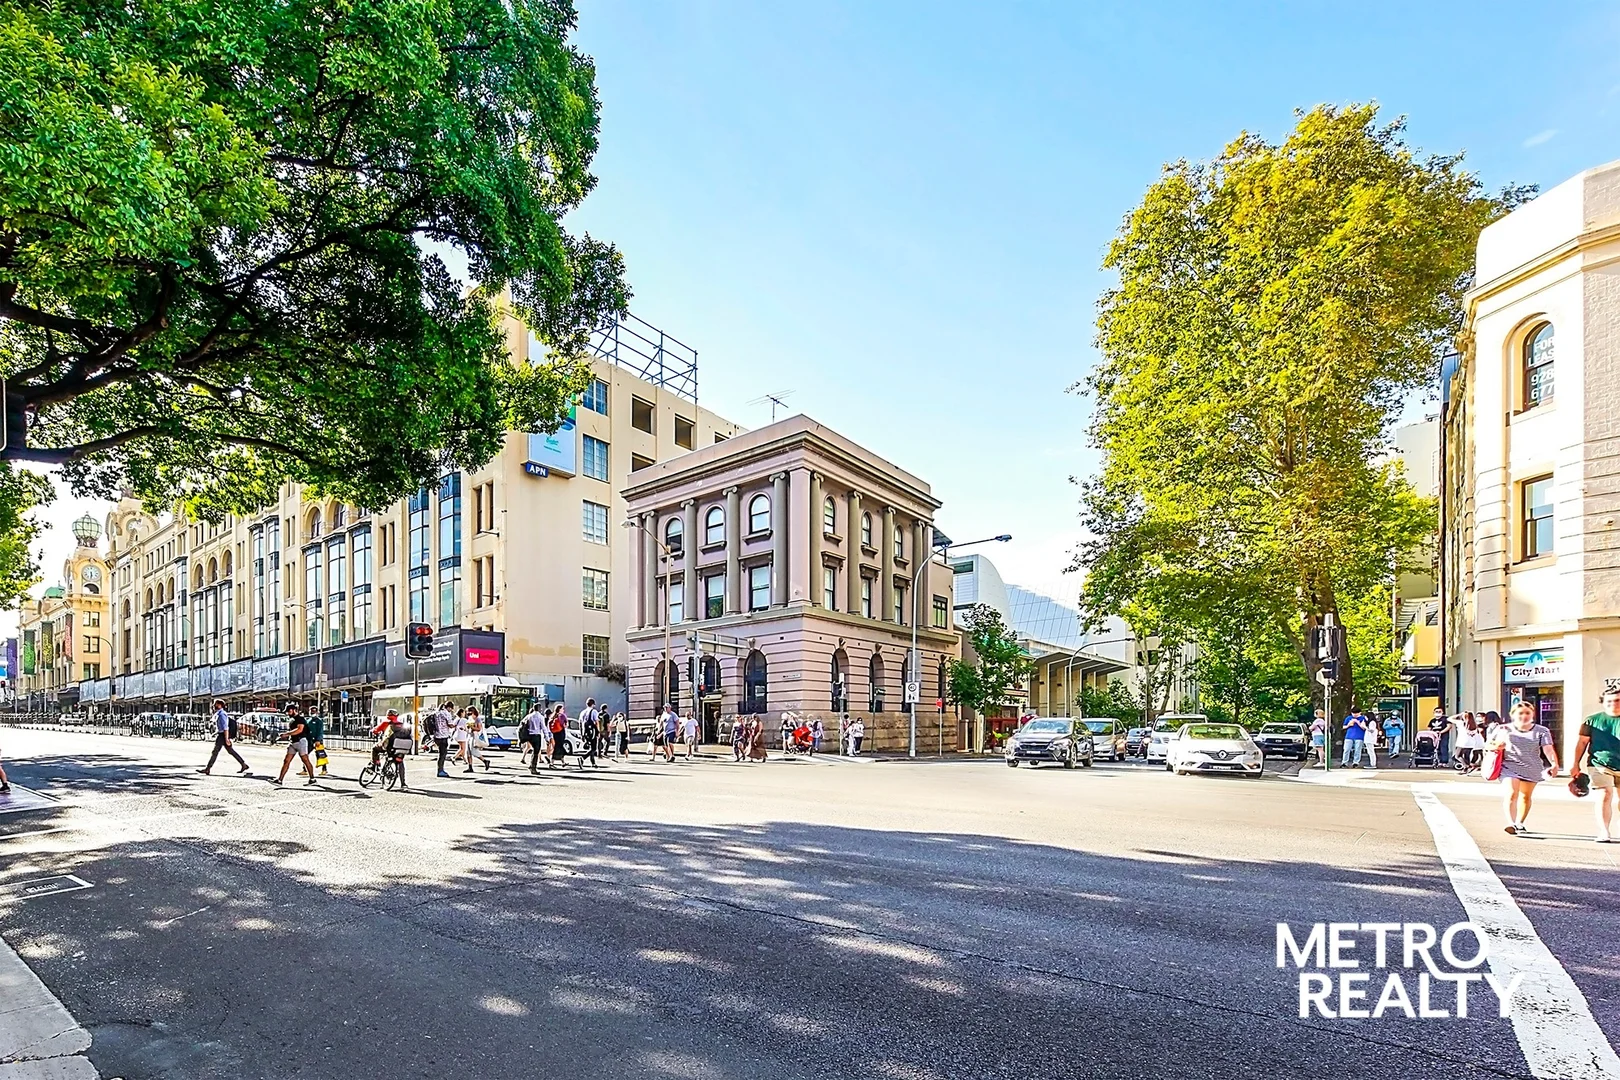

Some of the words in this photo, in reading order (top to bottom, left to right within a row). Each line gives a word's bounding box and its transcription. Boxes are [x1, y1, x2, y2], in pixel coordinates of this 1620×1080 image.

[530, 464, 546, 476] APN
[1511, 668, 1532, 677] City
[1534, 667, 1560, 675] Mart
